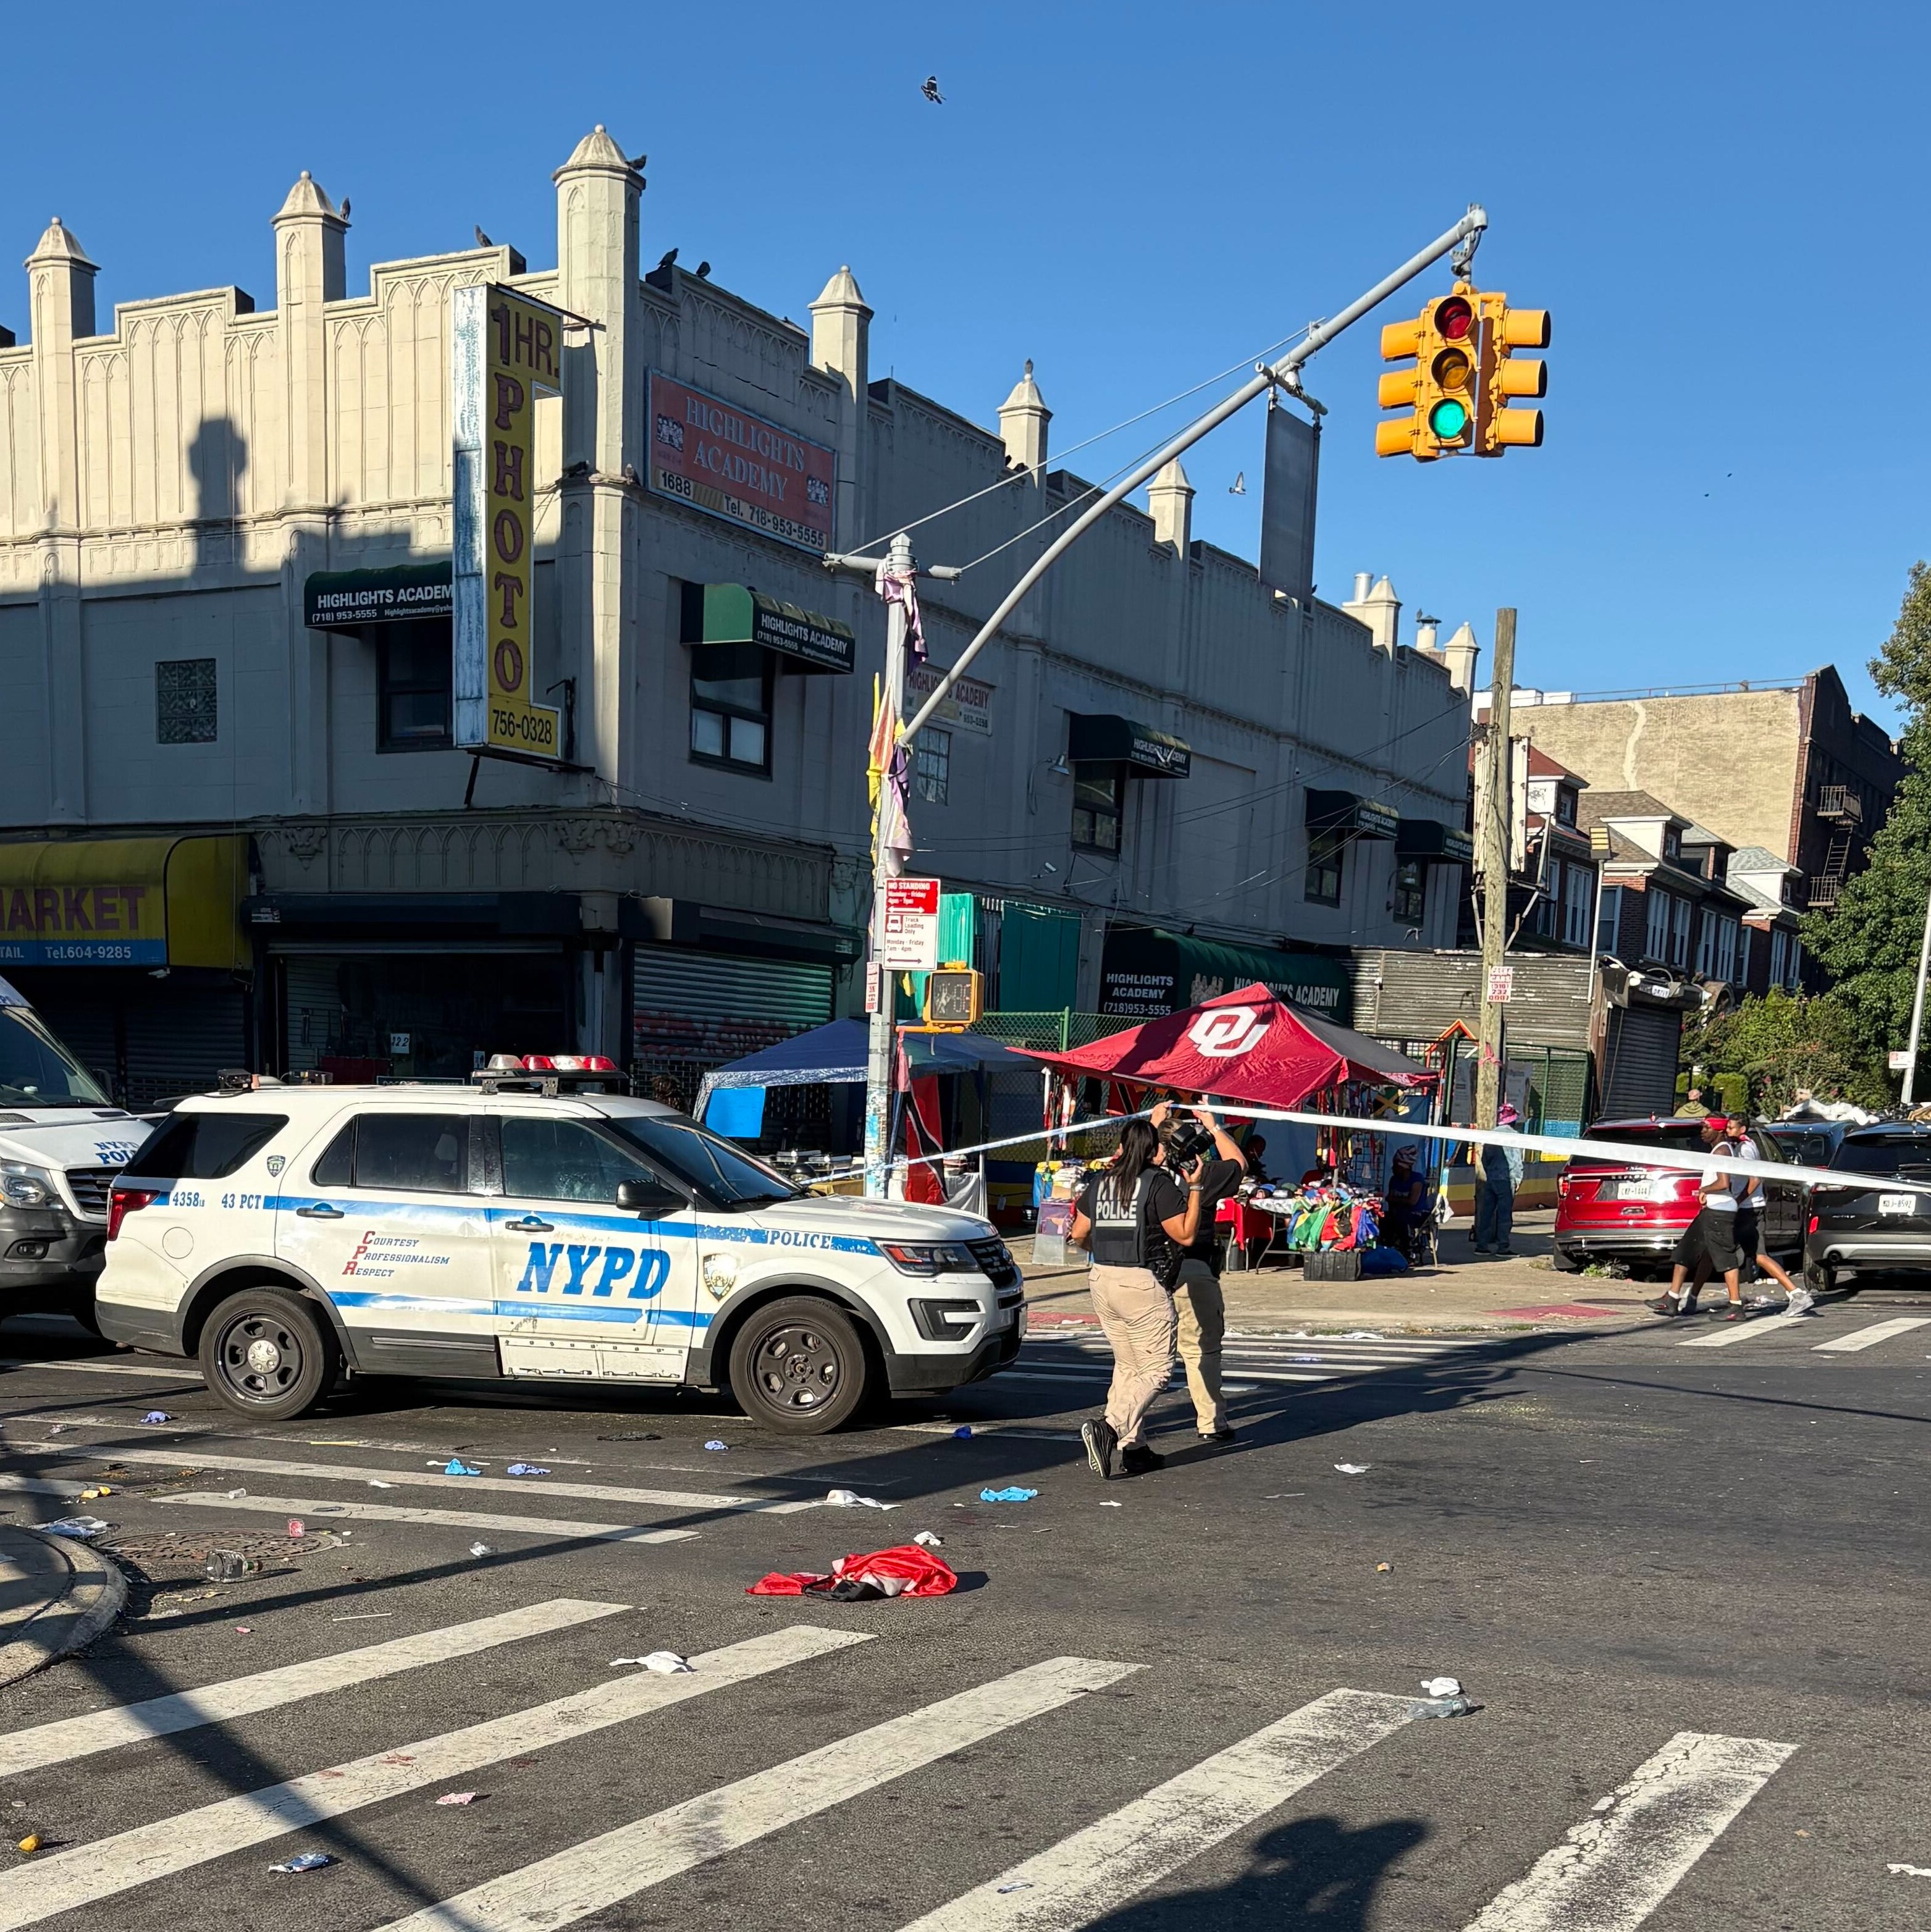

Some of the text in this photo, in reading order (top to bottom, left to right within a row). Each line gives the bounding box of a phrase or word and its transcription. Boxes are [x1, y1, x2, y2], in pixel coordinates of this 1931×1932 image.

[490, 302, 510, 366] 1
[686, 396, 805, 473] HIGHLIGHTS
[693, 440, 788, 502] ACADEMY
[662, 471, 692, 496] 1688
[725, 495, 744, 517] Tel.
[749, 505, 824, 548] 718-953-5555
[494, 371, 524, 693] PHOTO
[318, 584, 453, 609] HIGHLIGHTS ACADEM
[312, 612, 334, 624] (718)
[337, 609, 377, 620] 953-5555
[761, 613, 848, 655] HIGHLIGHTS ACADEMY
[909, 671, 990, 710] HIGHLIGS ACADEMY
[493, 709, 552, 745] 756-0328
[898, 882, 930, 891] STANDING
[0, 886, 145, 931] ARKET
[1106, 973, 1174, 986] HIGHLIGHTS
[1112, 987, 1166, 999] ACADEMY
[1295, 985, 1340, 1007] ACADEMY
[1103, 1002, 1171, 1015] (718)953-5555
[95, 1149, 137, 1165] POL
[172, 1191, 200, 1207] 4358
[221, 1193, 261, 1209] 43 PCT
[1095, 1200, 1138, 1220] POLICE
[362, 1230, 419, 1247] COURTESY
[769, 1230, 831, 1250] POLICE
[352, 1245, 450, 1265] PROFESSIONALISM
[342, 1261, 395, 1277] RESPECT
[516, 1241, 671, 1300] NYPD
